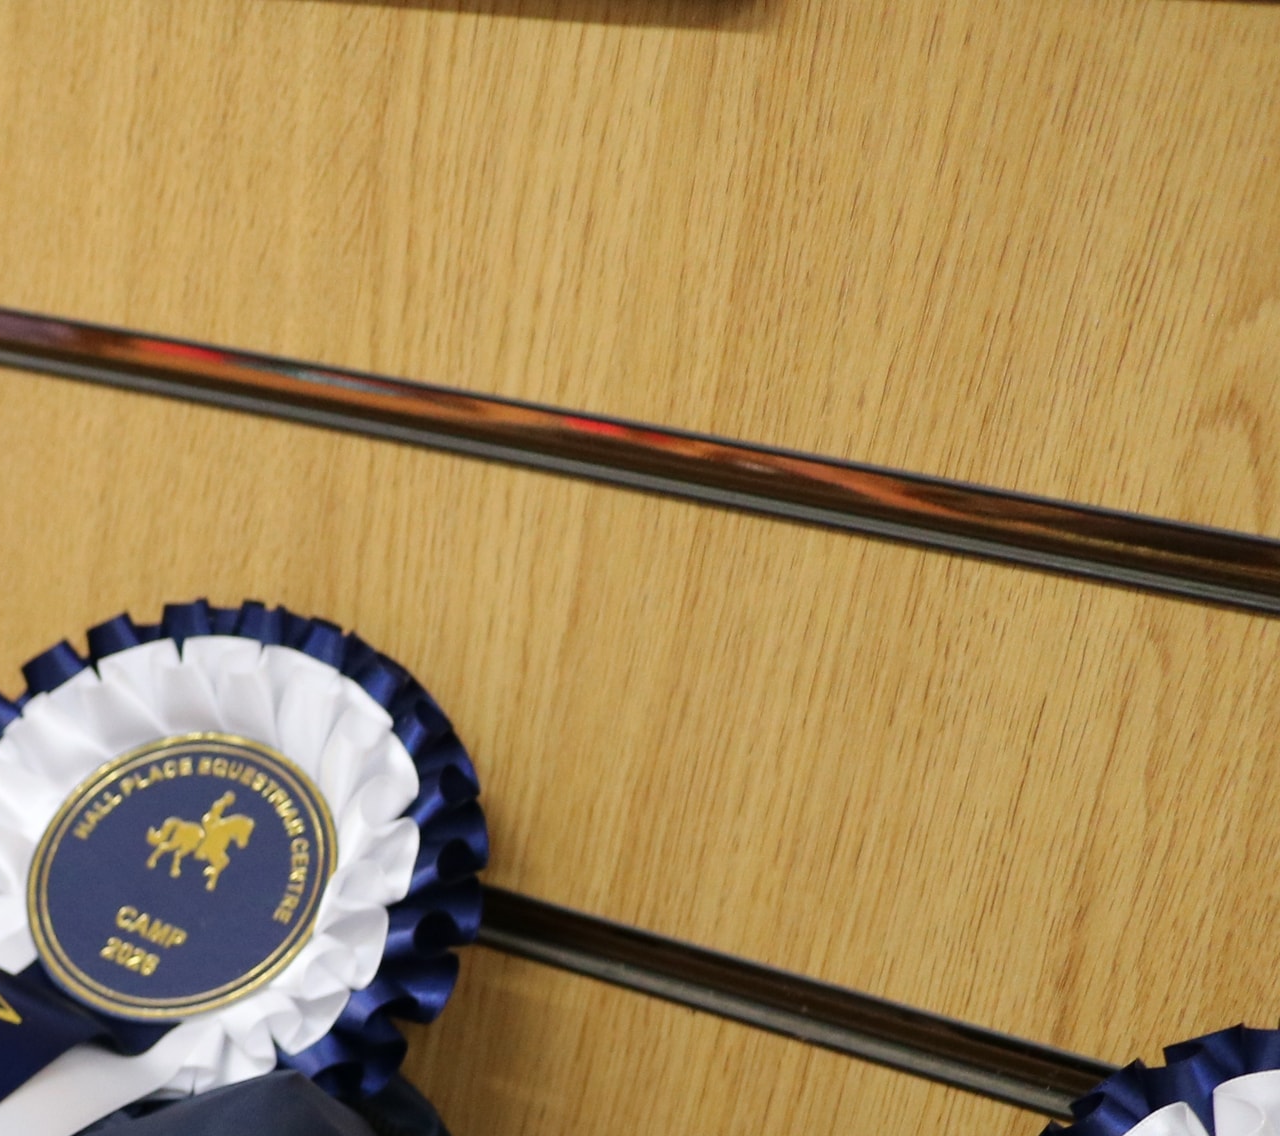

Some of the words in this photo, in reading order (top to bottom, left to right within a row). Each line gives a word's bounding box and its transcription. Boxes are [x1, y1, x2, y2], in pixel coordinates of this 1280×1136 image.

[73, 790, 123, 841] HALL
[119, 756, 193, 797] PLACE
[272, 838, 310, 926] CENTRE
[115, 905, 188, 949] CAMP
[100, 936, 161, 977] 2026
